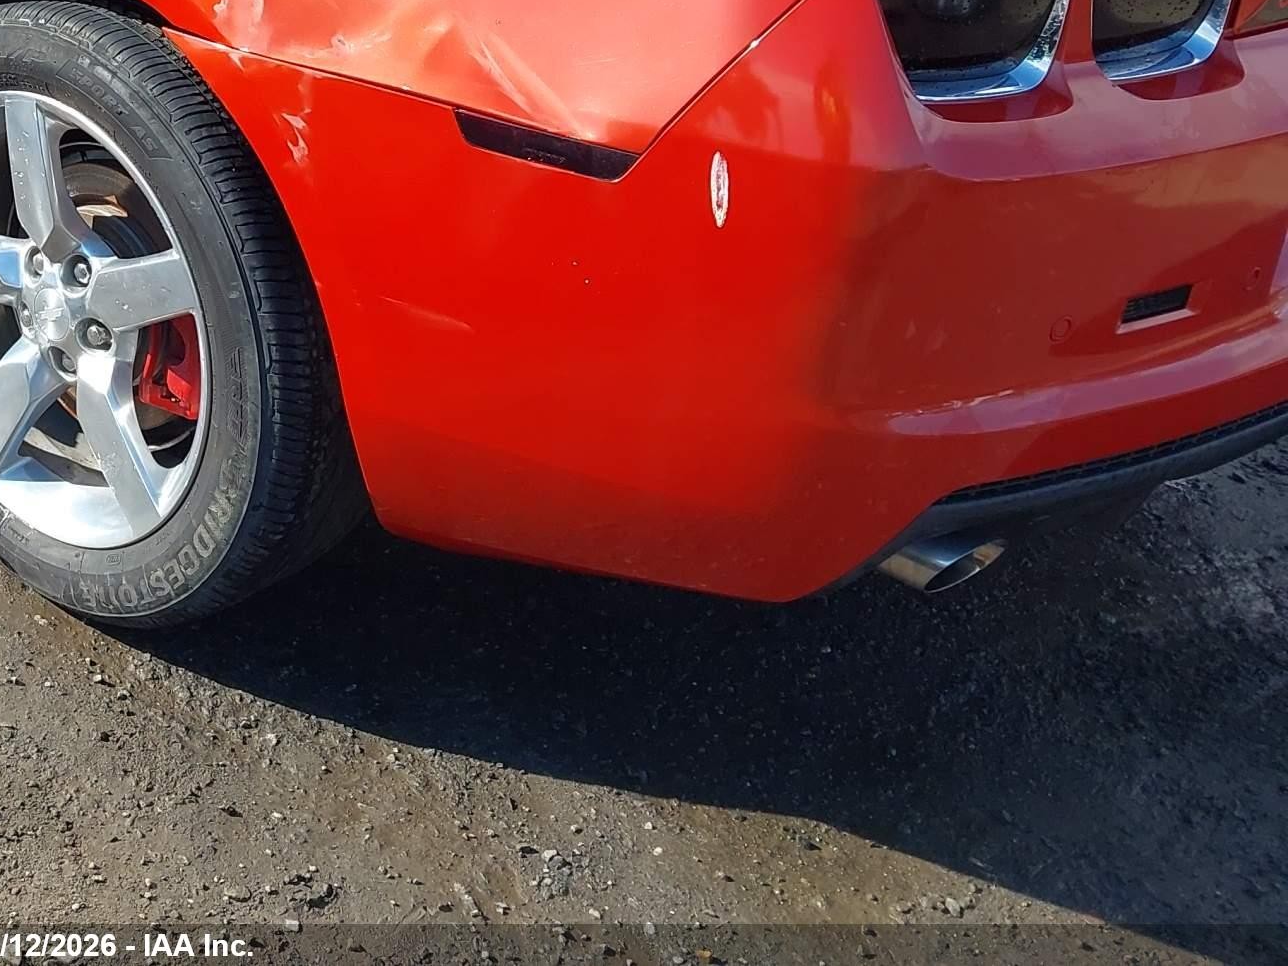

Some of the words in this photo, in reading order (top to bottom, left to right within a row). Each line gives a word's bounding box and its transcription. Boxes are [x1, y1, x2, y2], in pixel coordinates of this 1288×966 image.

[70, 66, 130, 117] SPORT
[127, 124, 160, 153] AS
[75, 456, 246, 610] BRIDGESTONE
